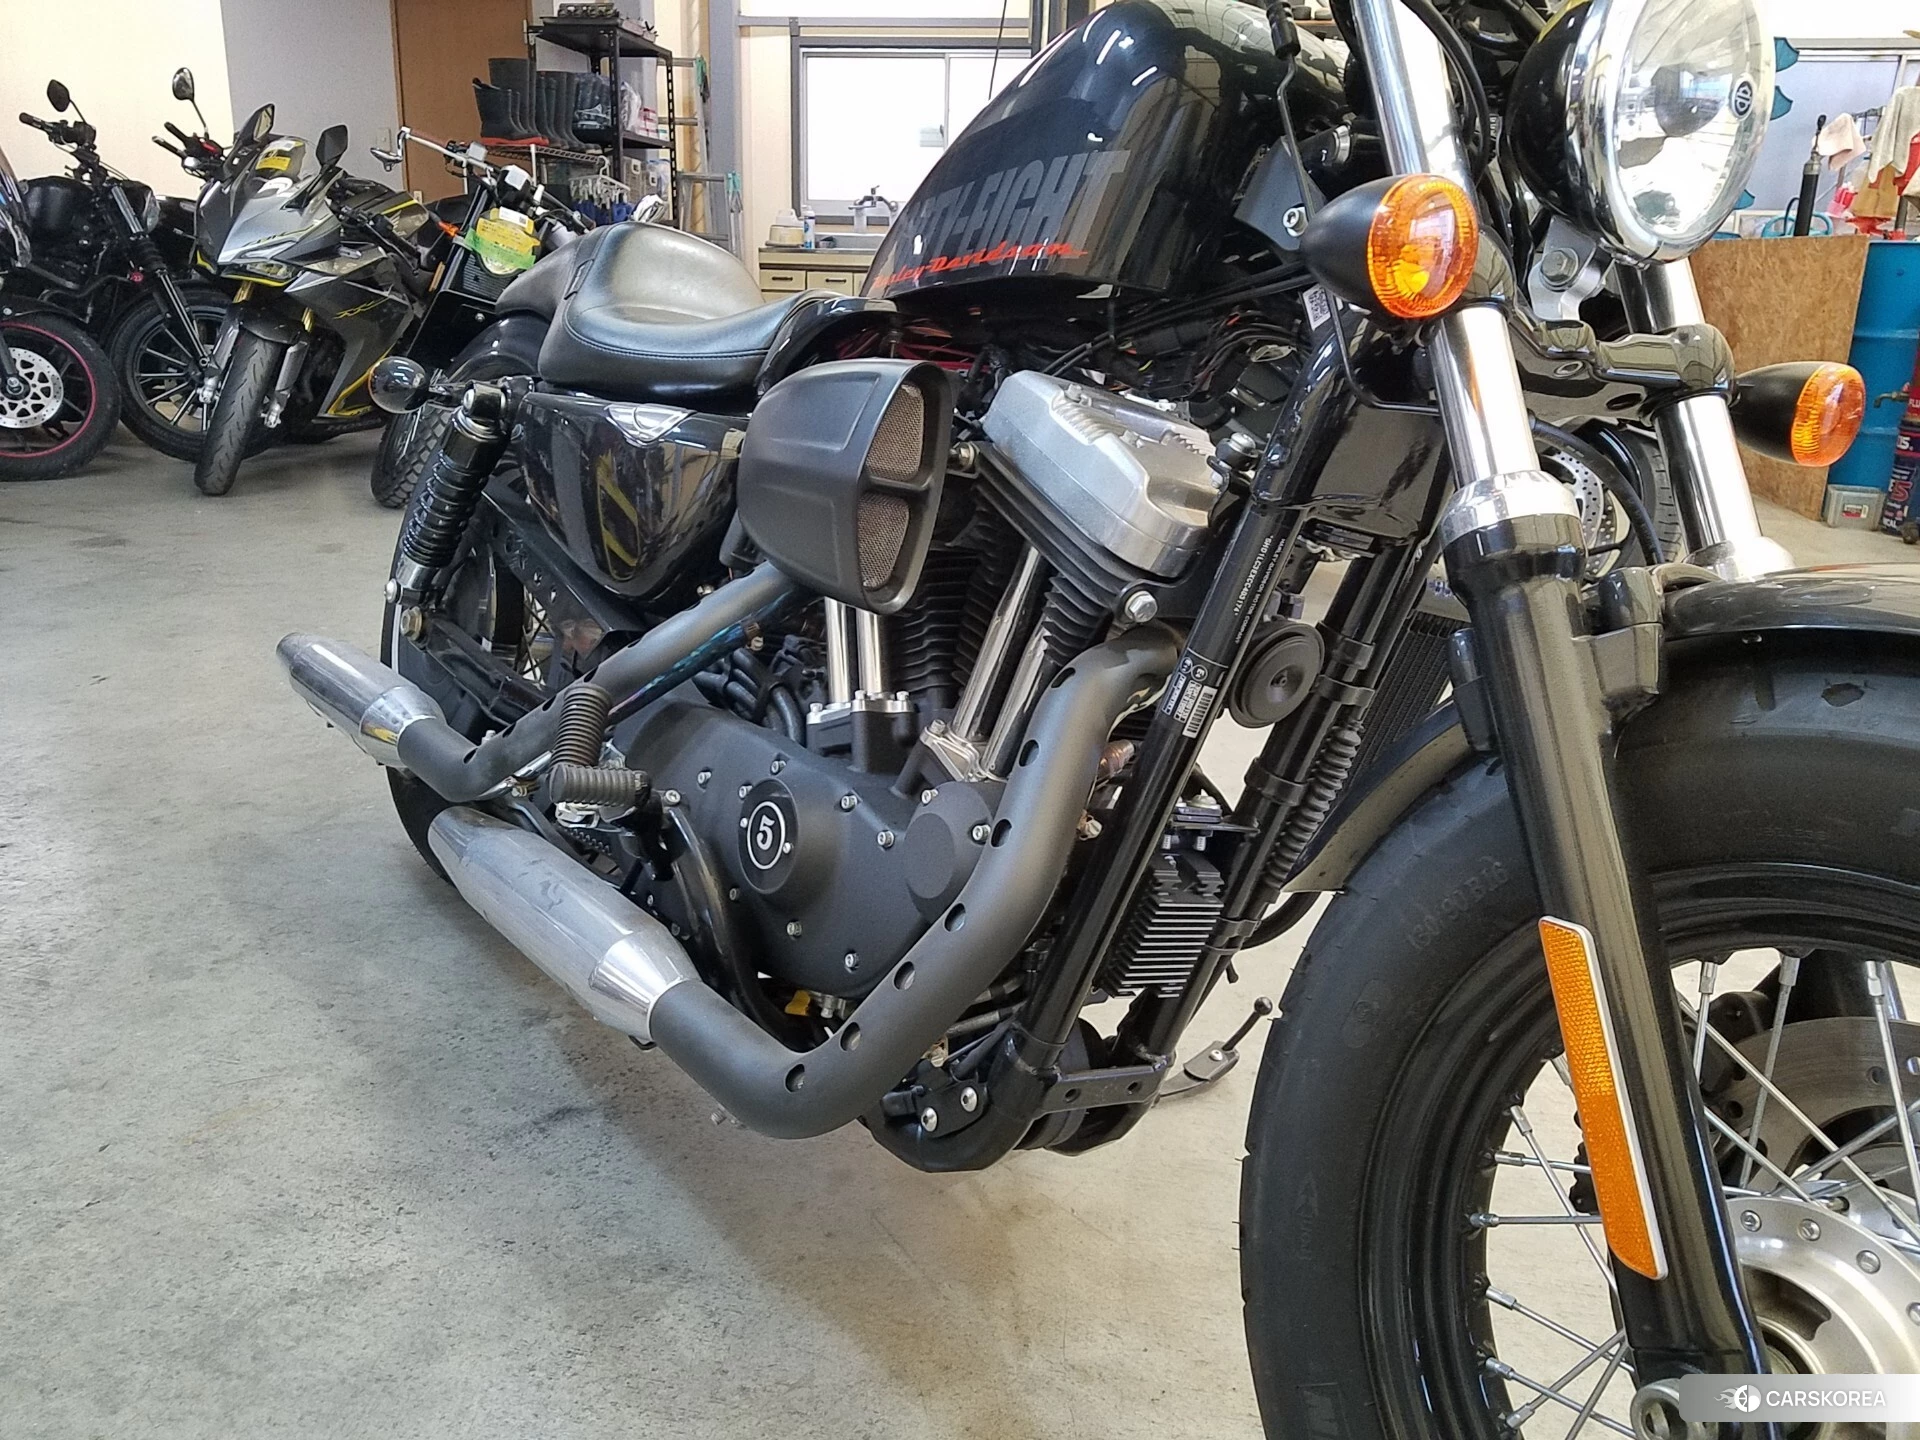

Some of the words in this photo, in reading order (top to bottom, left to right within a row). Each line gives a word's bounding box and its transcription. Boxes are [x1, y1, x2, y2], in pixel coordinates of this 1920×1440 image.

[1247, 593, 1261, 615] MOTOR
[1235, 615, 1250, 644] COMPANY
[756, 814, 776, 851] 5
